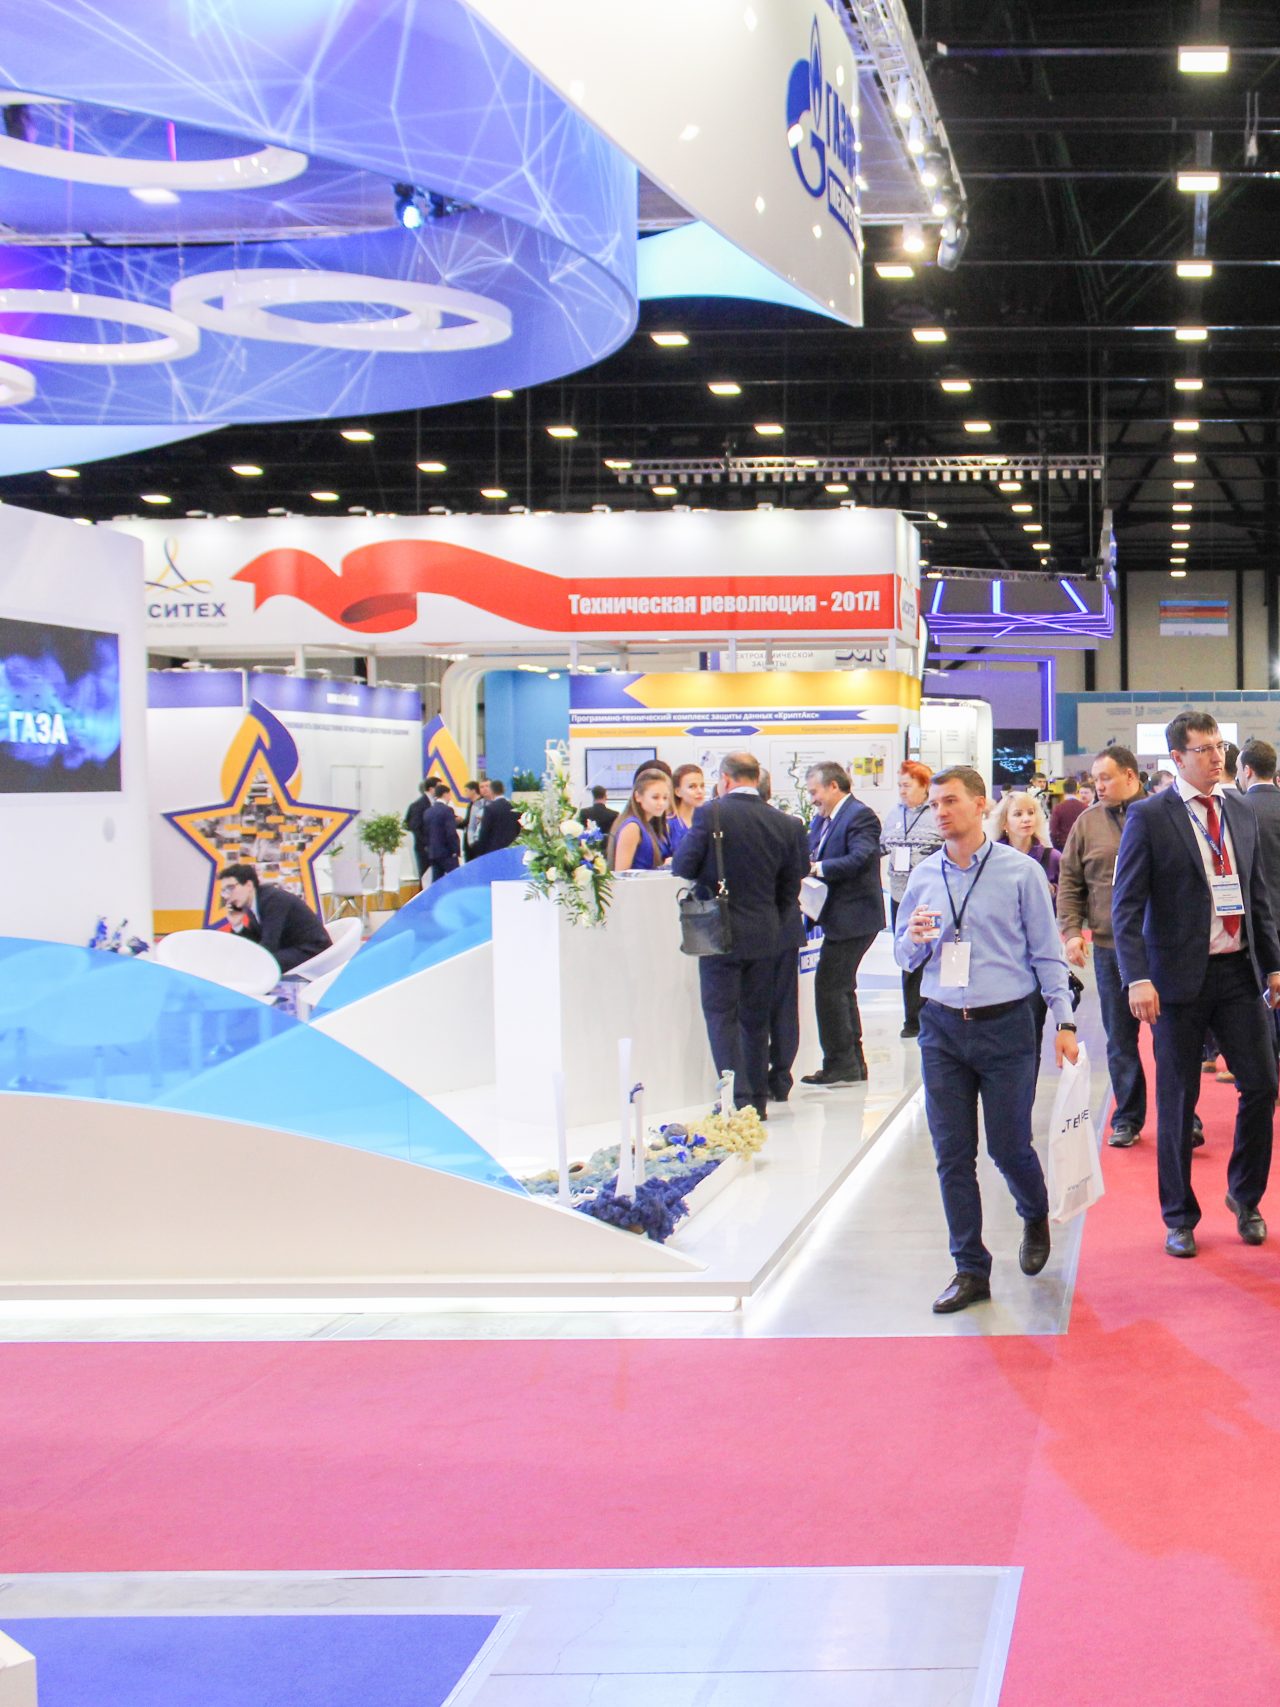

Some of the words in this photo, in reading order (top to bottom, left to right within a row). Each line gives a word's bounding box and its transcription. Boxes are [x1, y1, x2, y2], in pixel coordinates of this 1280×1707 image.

[148, 603, 226, 618] СИТЕХ
[569, 594, 697, 615] Техническая
[701, 594, 816, 615] революция
[831, 591, 880, 611] 2017!
[8, 710, 69, 745] ГАЗА
